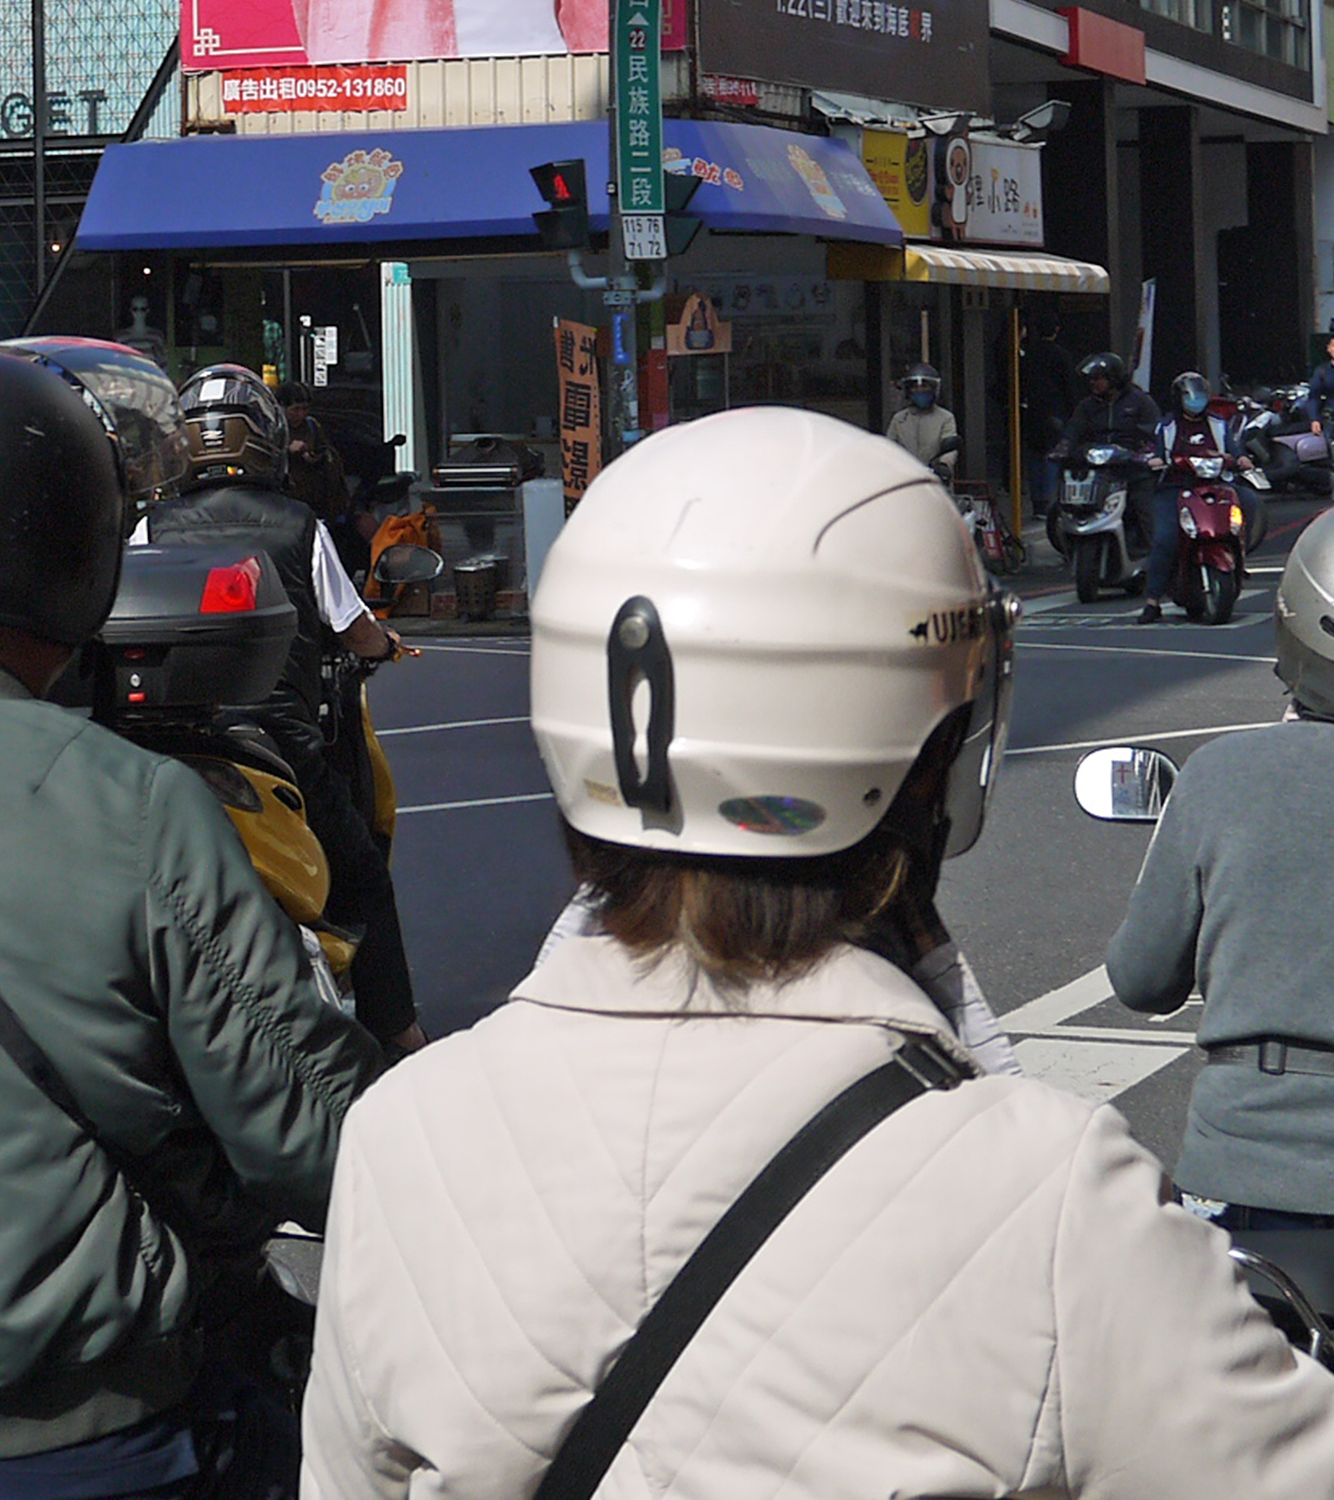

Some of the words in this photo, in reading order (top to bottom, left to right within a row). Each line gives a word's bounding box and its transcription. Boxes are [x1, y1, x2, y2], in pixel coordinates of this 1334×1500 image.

[629, 31, 646, 48] 22
[223, 77, 405, 102] 廣告出租0952-131860
[628, 54, 652, 205] 民族路二段
[624, 219, 643, 233] 115
[647, 218, 659, 233] 76
[629, 242, 643, 257] 71
[648, 241, 661, 256] 72
